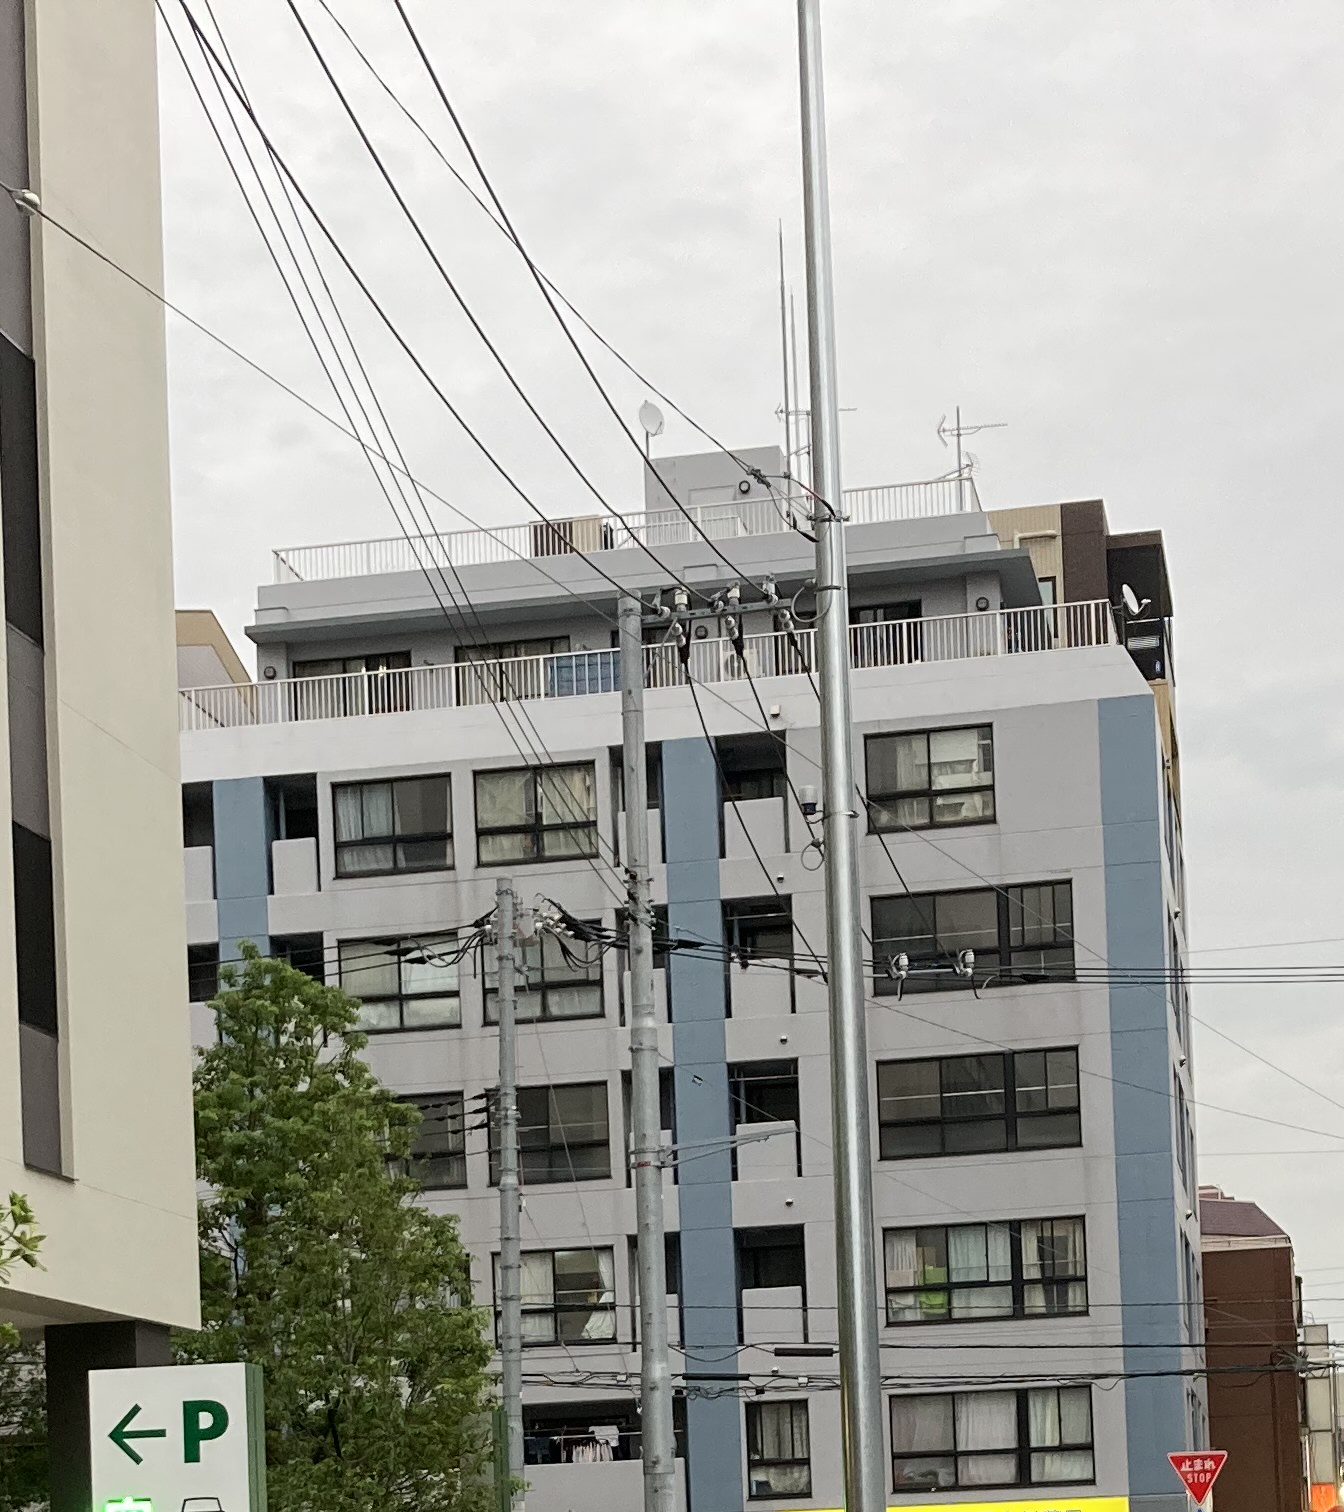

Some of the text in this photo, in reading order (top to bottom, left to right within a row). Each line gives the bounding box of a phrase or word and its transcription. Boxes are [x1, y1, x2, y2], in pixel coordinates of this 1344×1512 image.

[183, 1400, 229, 1463] P
[1181, 1458, 1215, 1472] 止まれ
[1187, 1473, 1212, 1484] STOP
